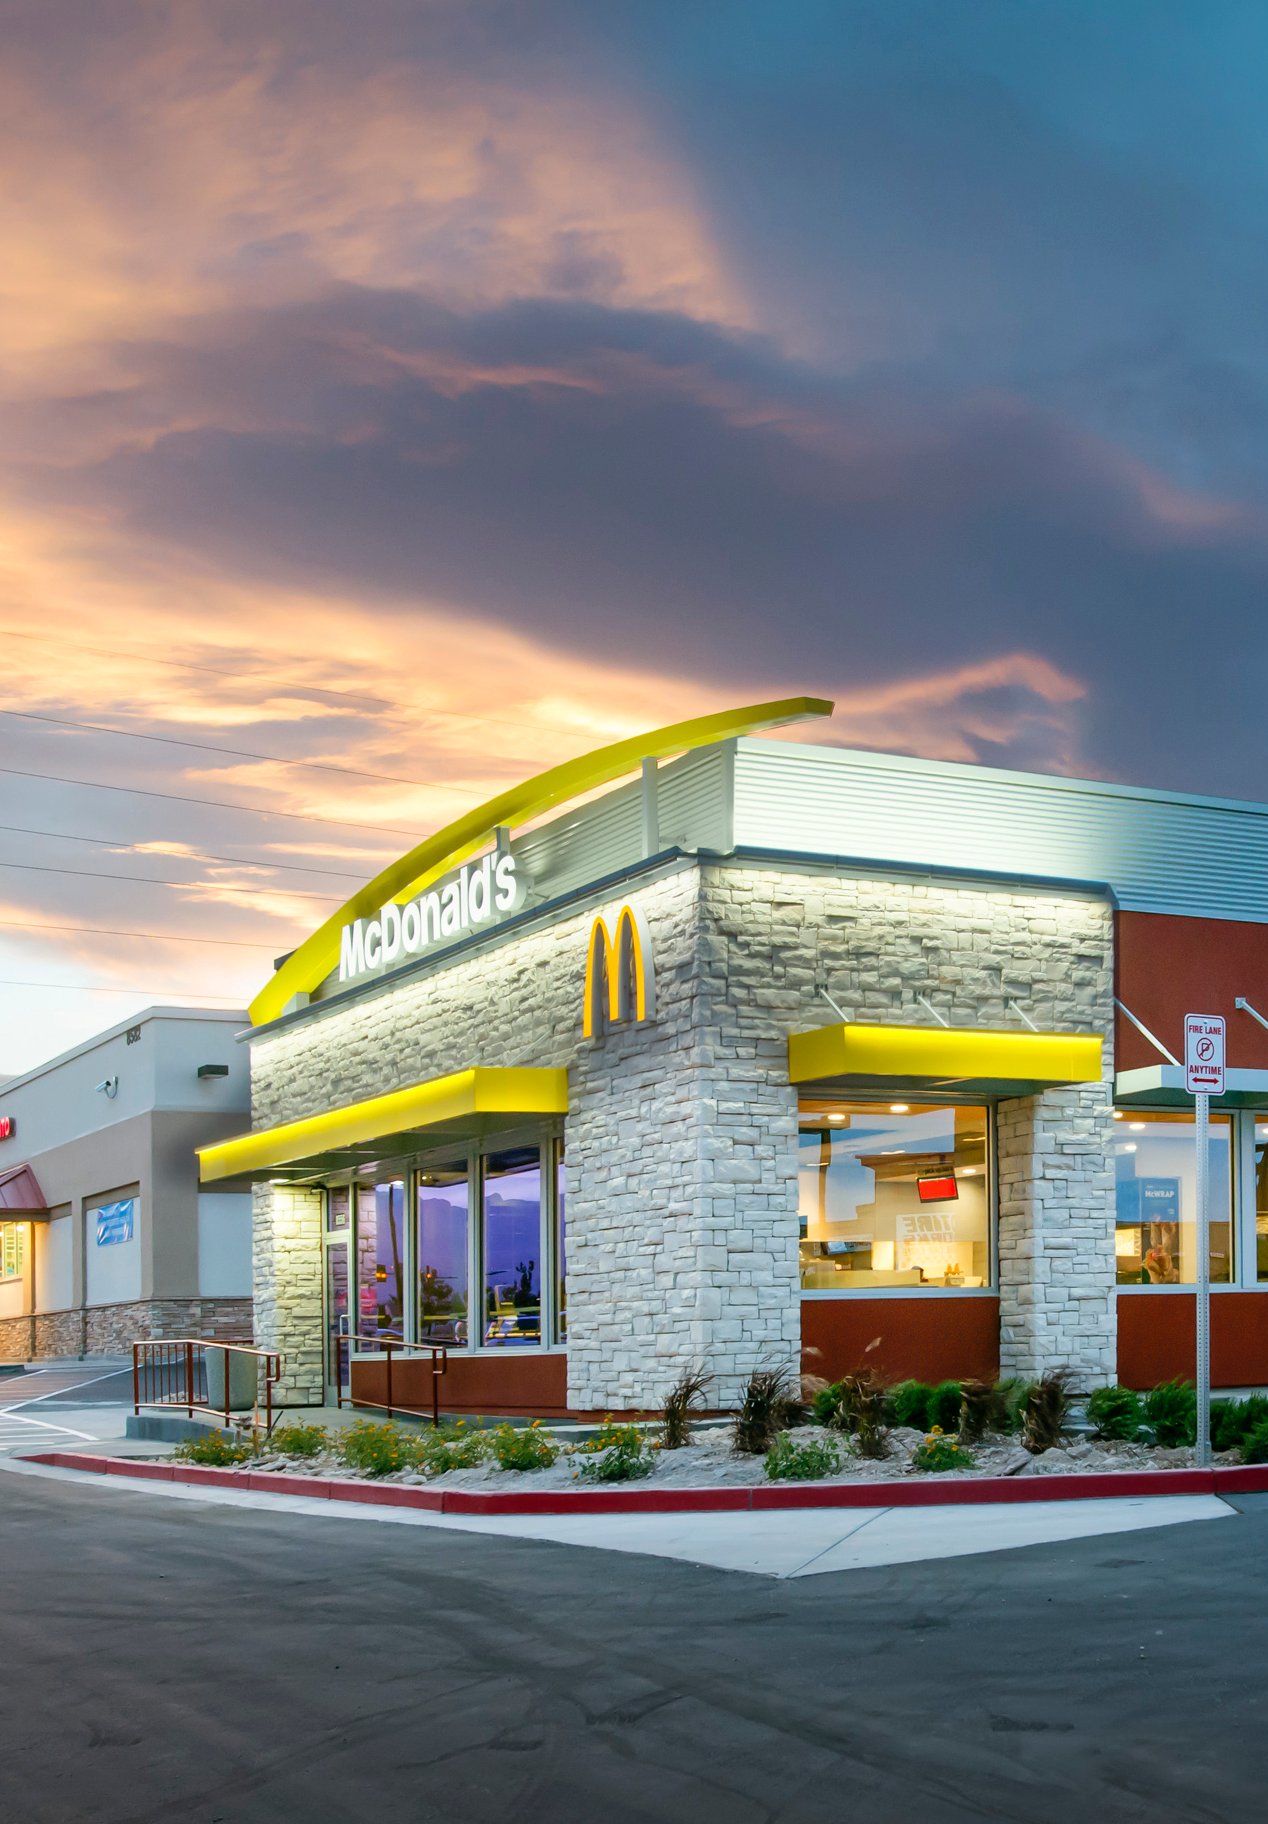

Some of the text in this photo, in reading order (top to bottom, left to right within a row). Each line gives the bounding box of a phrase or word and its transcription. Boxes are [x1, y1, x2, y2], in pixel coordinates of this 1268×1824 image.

[339, 853, 517, 982] McDonald's
[1188, 1024, 1222, 1035] FIRE LANE
[1189, 1064, 1222, 1075] ANYTIME
[1145, 1190, 1175, 1198] McWRAP
